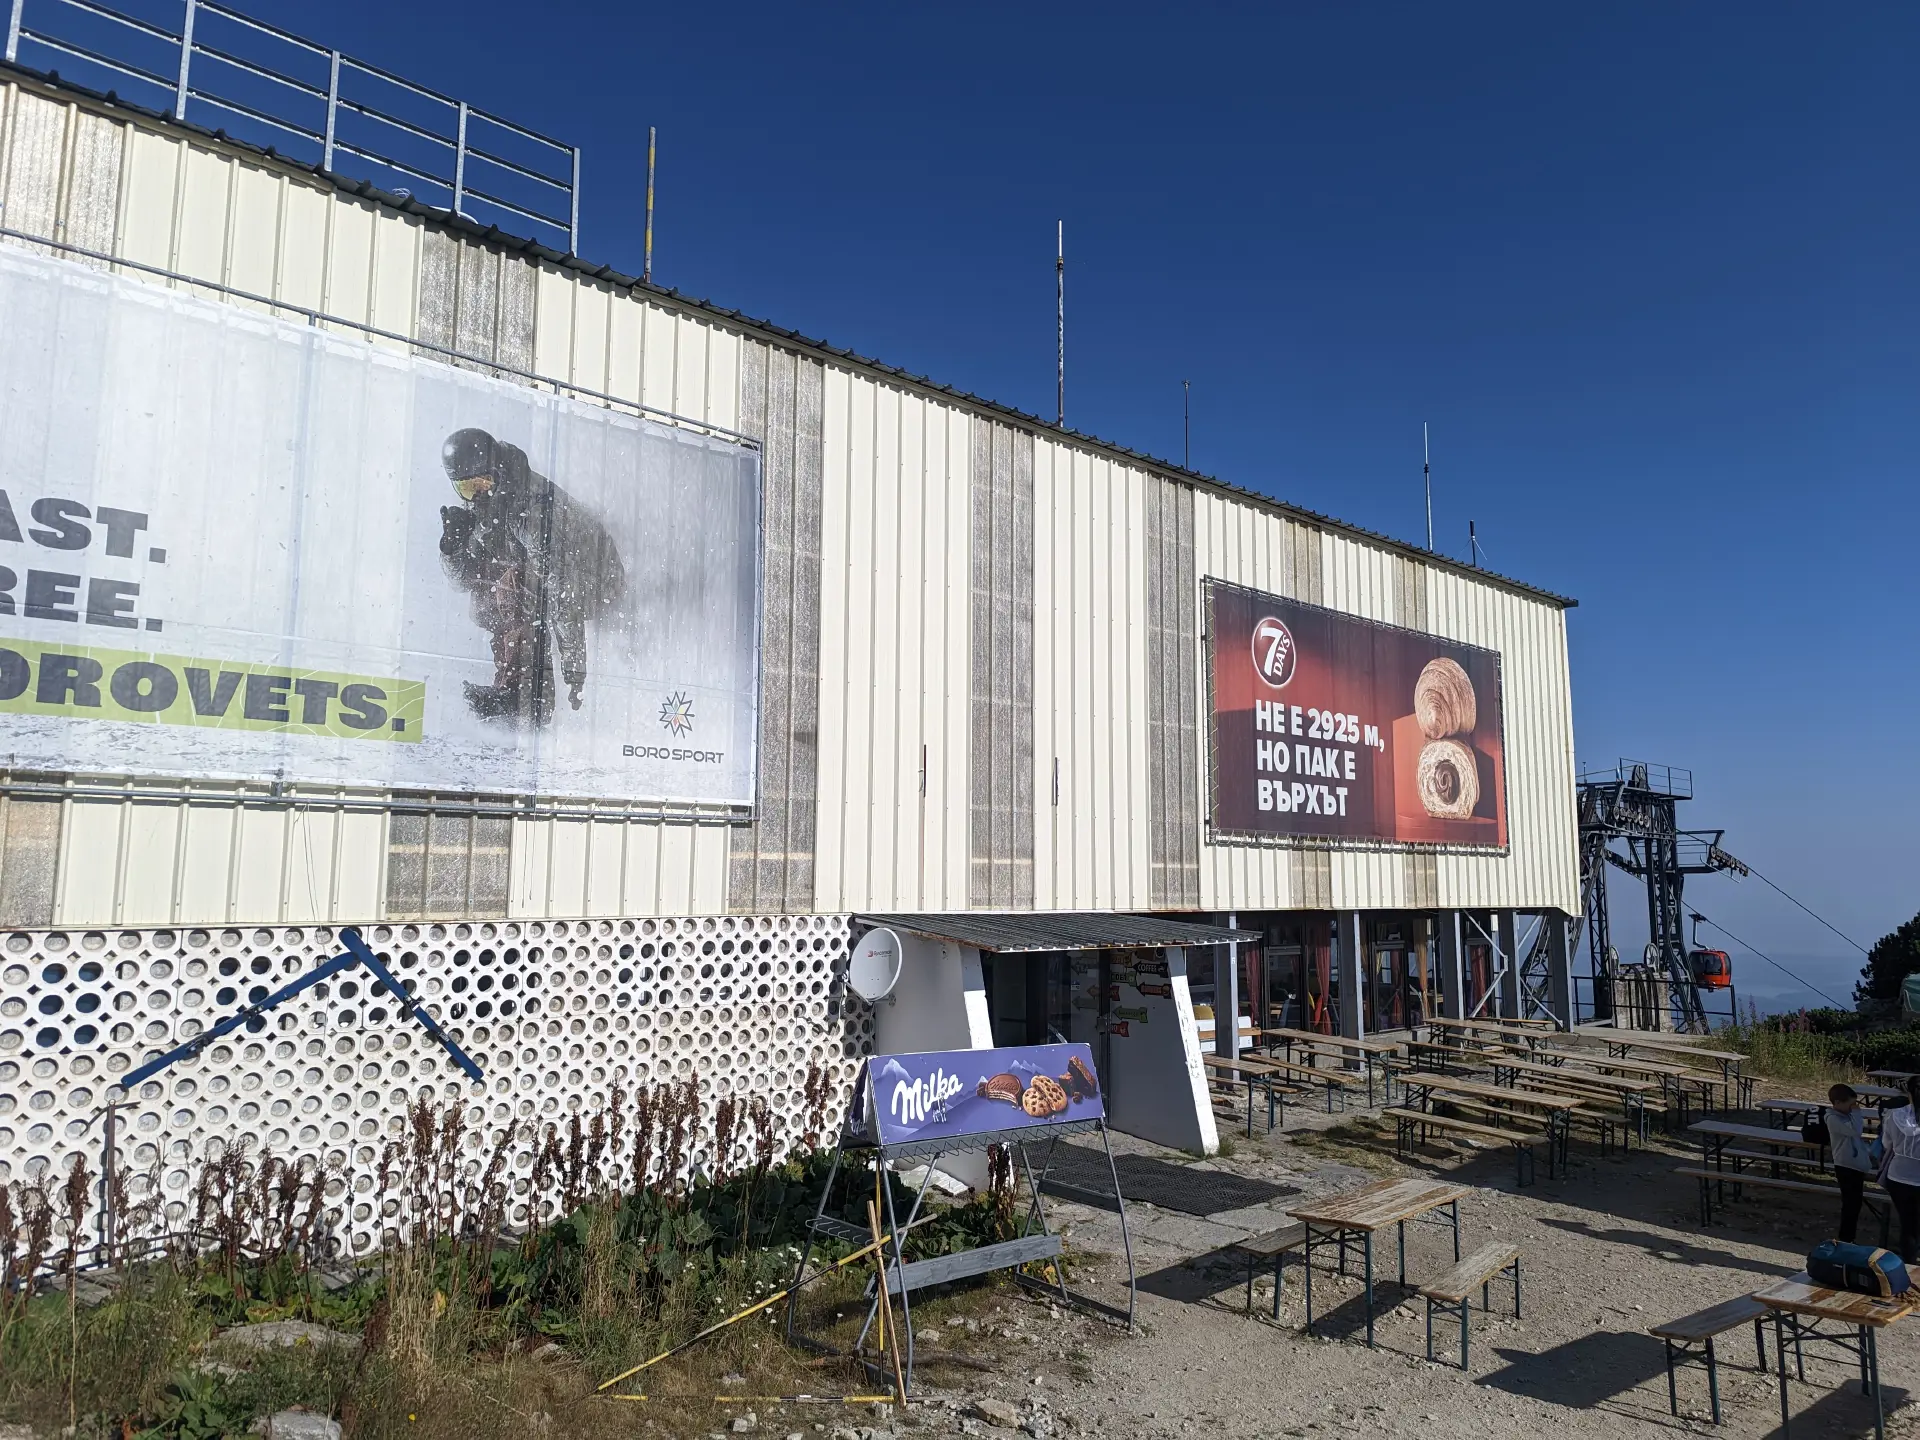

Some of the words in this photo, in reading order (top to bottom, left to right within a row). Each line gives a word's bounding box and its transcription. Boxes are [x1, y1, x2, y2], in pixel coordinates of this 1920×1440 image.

[0, 565, 163, 632] EE.
[1260, 627, 1284, 677] 7
[1273, 634, 1291, 677] DAYS
[1256, 699, 1285, 734] НЕ
[1291, 705, 1303, 736] Е
[1307, 708, 1360, 744] 2925
[1256, 739, 1290, 773] НО
[1295, 744, 1340, 779] ПАК
[1344, 750, 1356, 780] Е
[1257, 778, 1348, 816] ВЪРХЪТ
[891, 1067, 963, 1125] Milka
